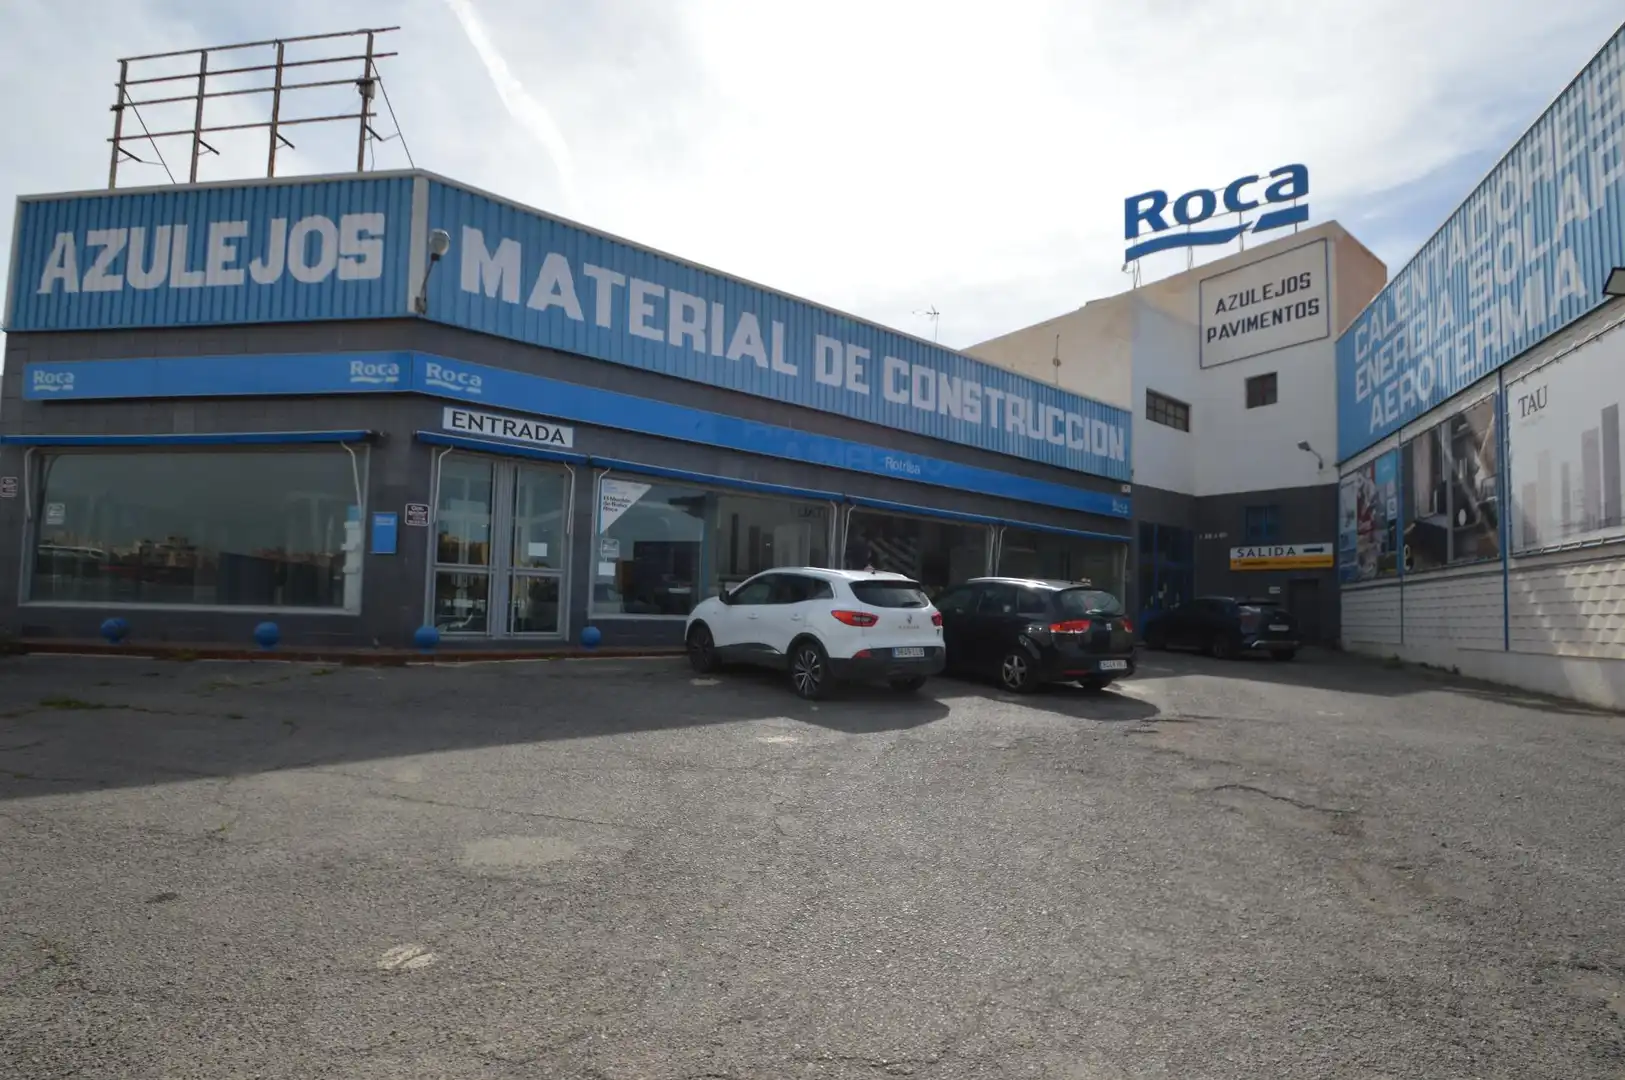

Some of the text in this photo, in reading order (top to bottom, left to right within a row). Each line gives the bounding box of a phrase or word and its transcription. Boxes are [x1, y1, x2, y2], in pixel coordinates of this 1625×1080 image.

[1124, 163, 1309, 240] Roca
[37, 212, 386, 294] AZULEJOS
[1214, 271, 1312, 316] AZULEJOS
[461, 224, 1125, 462] MATERIAL DE CONSTRUCCION
[1206, 297, 1320, 344] PAVIMENTOS
[1369, 248, 1589, 435] AEROTERMIA
[350, 360, 399, 377] Roca
[1355, 290, 1453, 403] ENERGIA
[33, 369, 75, 386] Roca
[425, 361, 483, 388] Roca
[1517, 384, 1548, 419] TAU
[451, 410, 566, 445] ENTRADA
[1237, 546, 1297, 558] SALIDA
